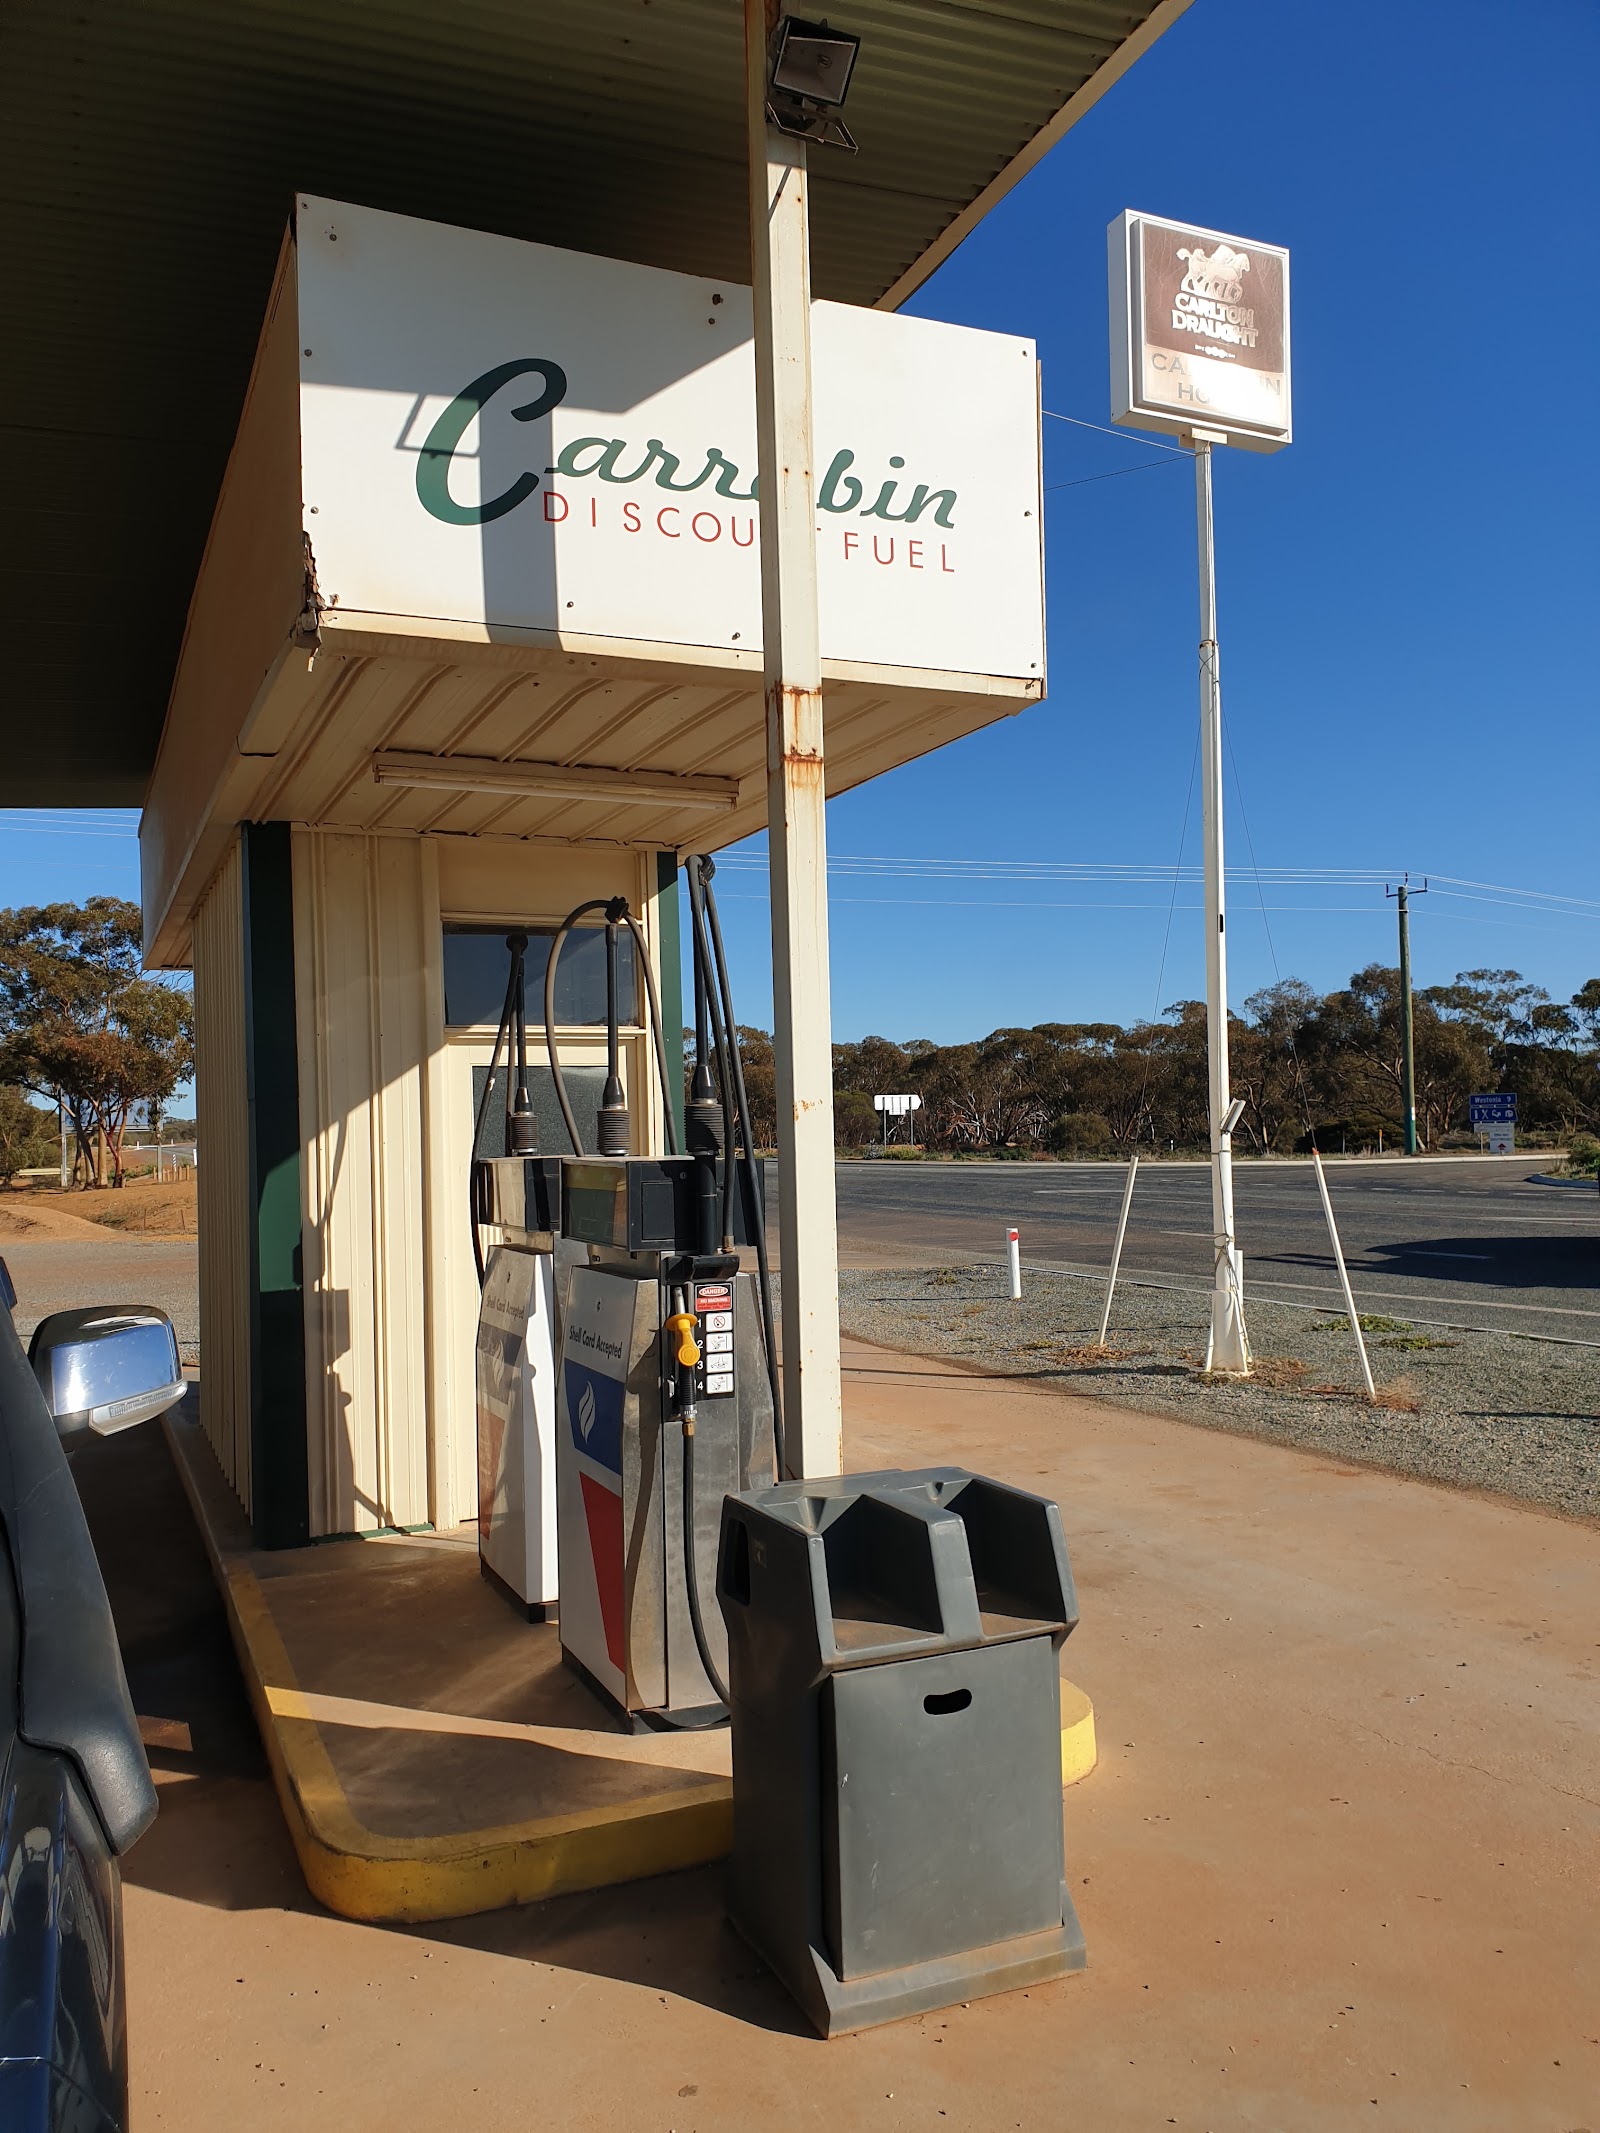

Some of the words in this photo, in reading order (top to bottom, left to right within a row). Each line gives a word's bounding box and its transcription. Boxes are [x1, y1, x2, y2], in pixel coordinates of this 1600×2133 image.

[1175, 292, 1254, 328] CARLTON
[1171, 309, 1258, 348] DRAUGHT
[415, 358, 957, 529] Carrbin
[544, 491, 821, 547] DISCOU
[844, 531, 955, 572] FUEL
[486, 1294, 497, 1308] Shell
[496, 1298, 506, 1312] Card
[506, 1301, 525, 1319] Accepted
[697, 1318, 701, 1328] 1
[569, 1325, 582, 1343] Shell
[582, 1330, 596, 1348] Card
[595, 1337, 623, 1359] Accepted
[697, 1339, 703, 1349] 2
[697, 1360, 703, 1370] 3
[697, 1381, 704, 1391] 4
